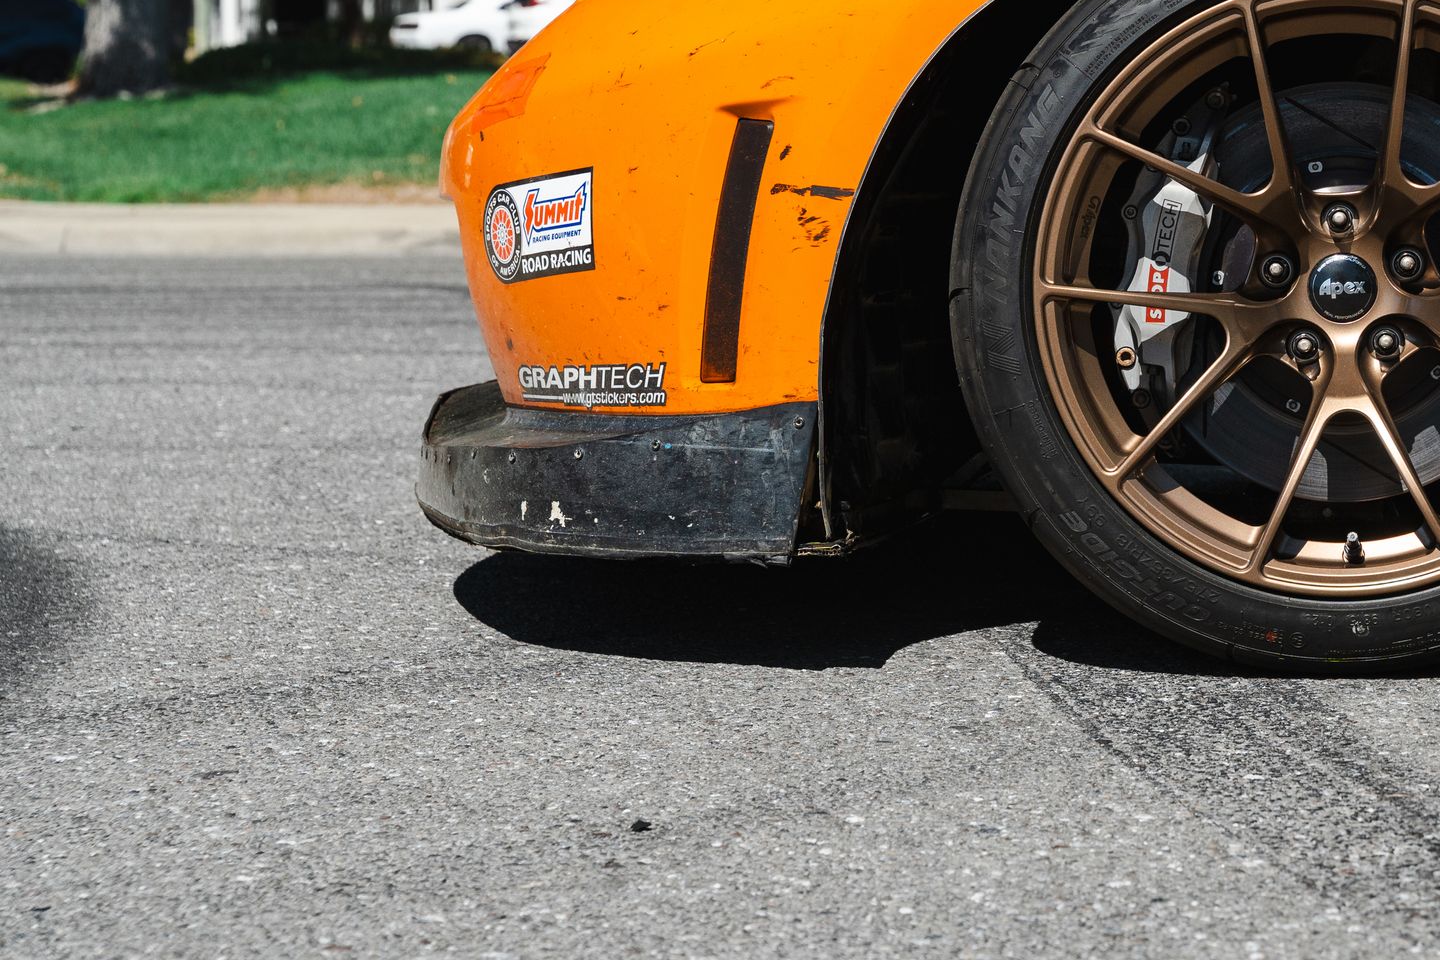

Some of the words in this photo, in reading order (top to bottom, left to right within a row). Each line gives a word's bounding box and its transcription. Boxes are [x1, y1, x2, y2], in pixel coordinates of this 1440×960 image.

[982, 83, 1063, 304] NANKANG
[497, 194, 510, 205] CAR
[509, 204, 520, 234] CLUB
[533, 233, 550, 244] RACING
[551, 229, 582, 241] EQUIPMENT
[500, 249, 520, 275] AMERICA
[522, 254, 549, 274] ROAD
[550, 247, 592, 269] RACING
[1319, 278, 1366, 299] Apex
[519, 365, 665, 389] GRAPHTECH
[563, 391, 666, 407] www.gtstickers.com
